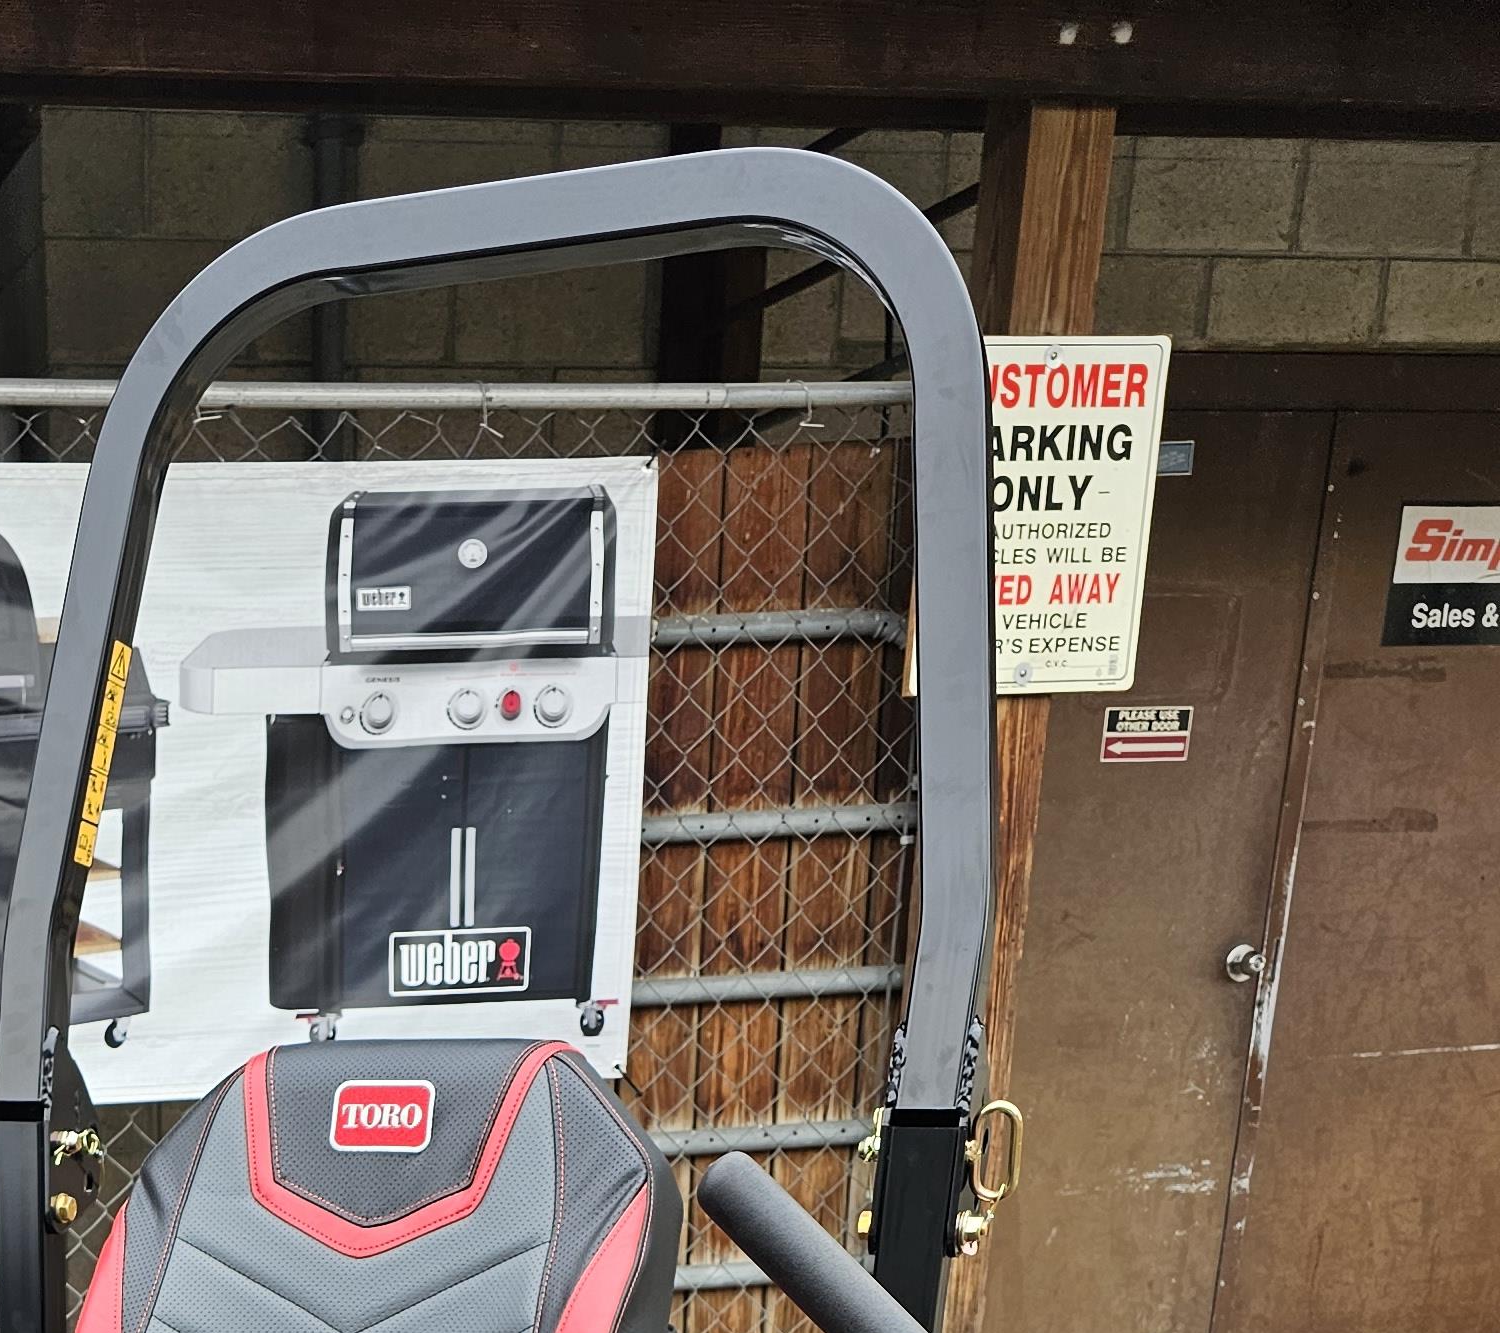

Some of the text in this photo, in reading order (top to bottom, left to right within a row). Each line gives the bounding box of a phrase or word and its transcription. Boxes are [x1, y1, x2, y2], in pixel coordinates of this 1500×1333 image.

[990, 363, 1149, 409] STOMER
[993, 424, 1133, 462] ARKING
[993, 475, 1094, 512] ONLY
[1047, 547, 1092, 564] WILL
[1101, 547, 1127, 563] BE
[362, 588, 397, 607] weber
[1049, 573, 1121, 605] AWAY
[1002, 613, 1088, 630] VEHICLE
[1411, 602, 1499, 629] Sales &
[1029, 636, 1120, 654] EXPENSE
[399, 934, 496, 987] weber
[341, 1103, 423, 1129] TORO
